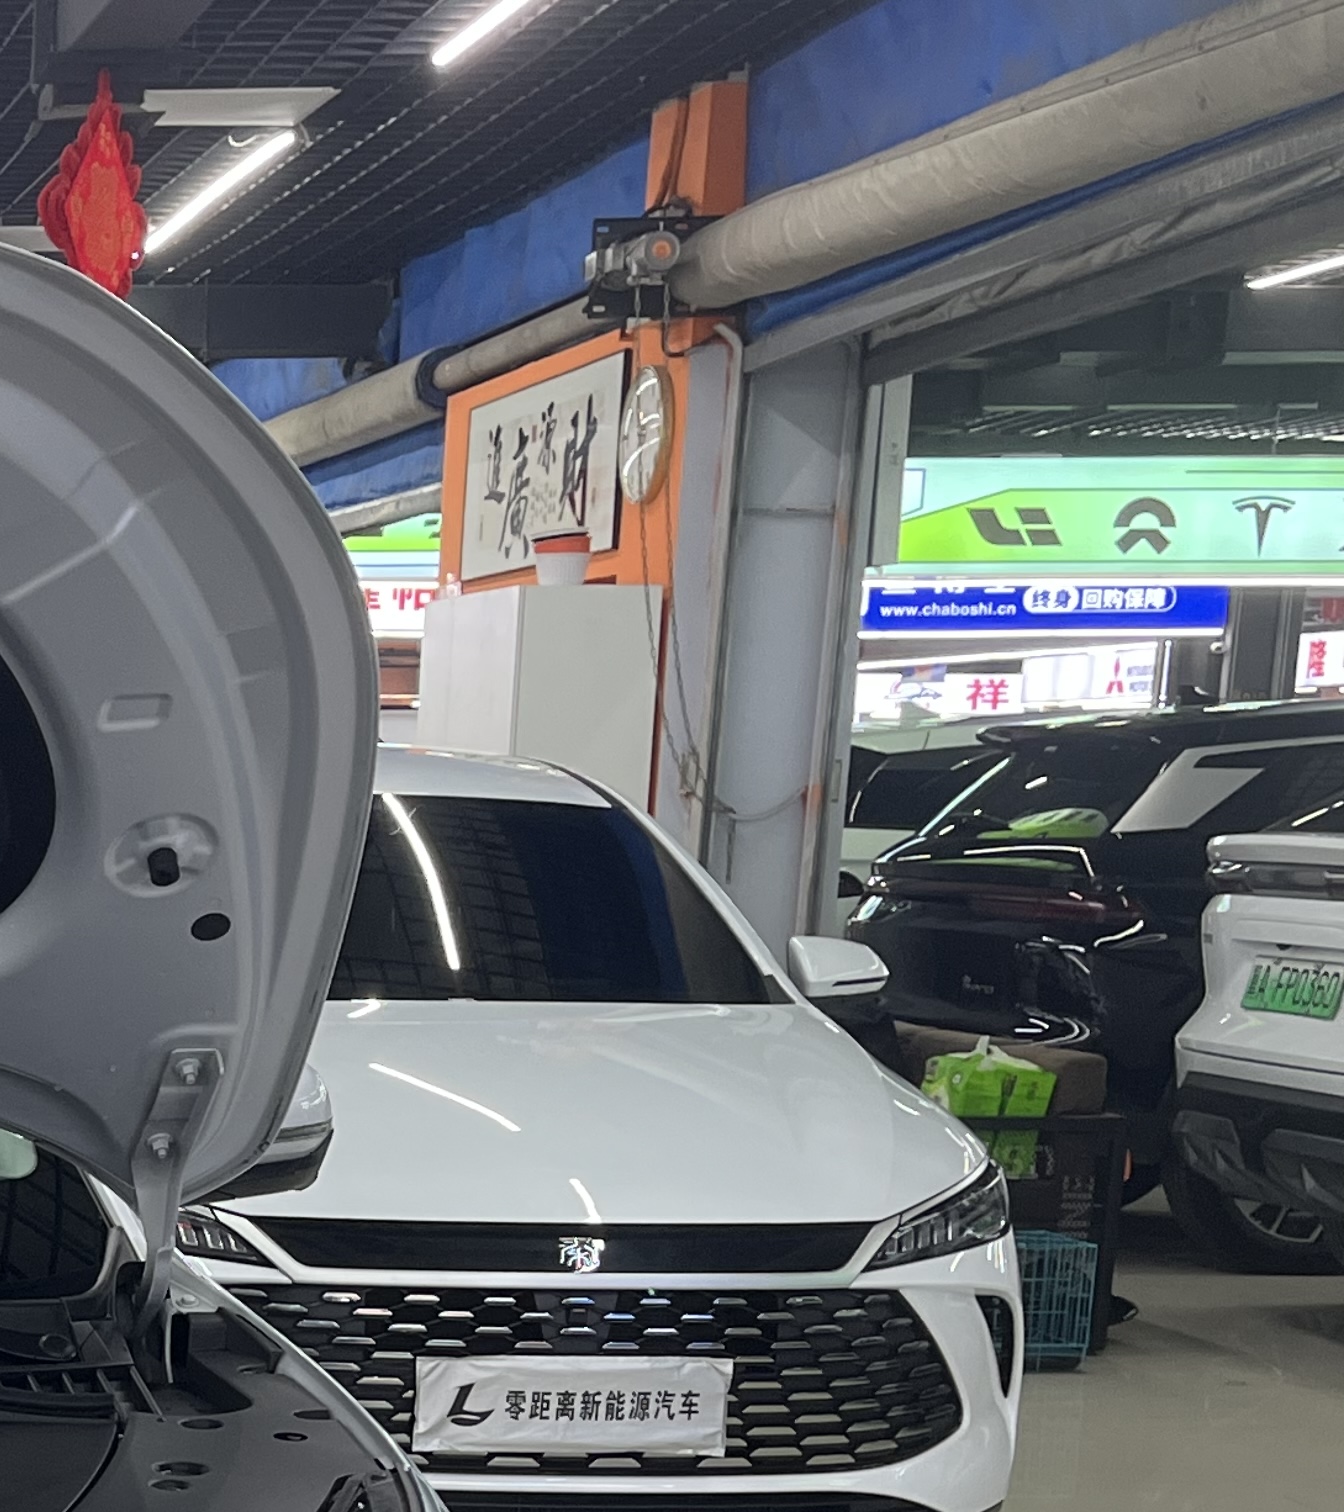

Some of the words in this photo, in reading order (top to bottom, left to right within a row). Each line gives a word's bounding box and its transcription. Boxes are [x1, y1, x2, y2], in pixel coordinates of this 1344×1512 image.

[879, 601, 1017, 618] www.chaboshi.cn
[966, 678, 1010, 711] 祥
[504, 1389, 701, 1422] 零距离新能源汽车
